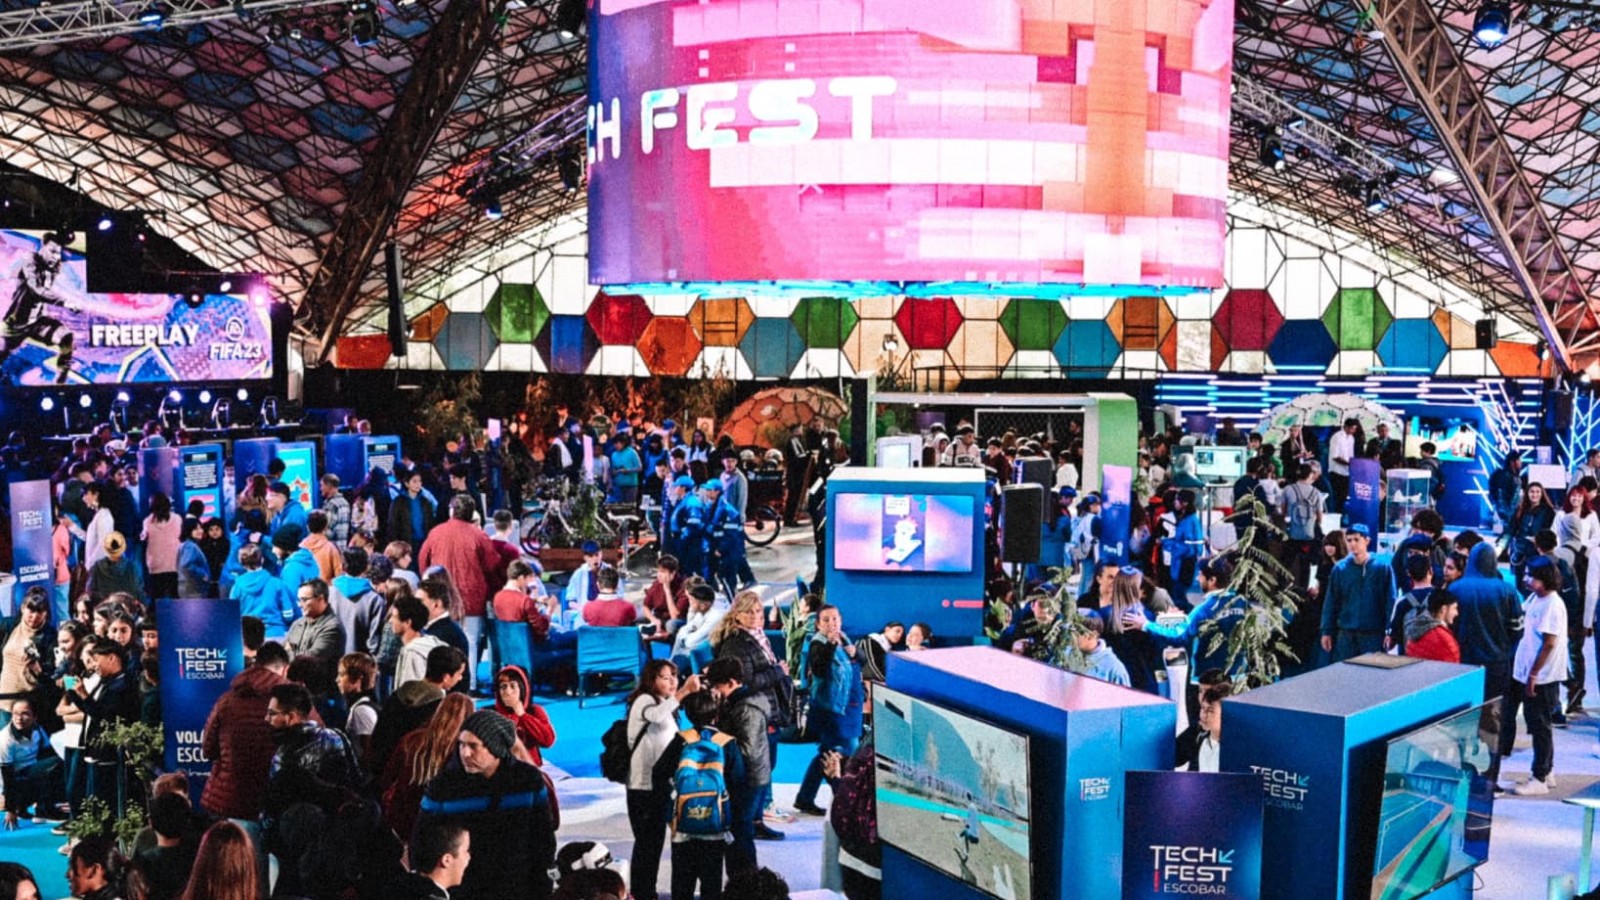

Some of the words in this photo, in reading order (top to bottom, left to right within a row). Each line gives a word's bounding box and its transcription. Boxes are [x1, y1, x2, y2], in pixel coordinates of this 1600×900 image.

[641, 76, 897, 154] FEST
[92, 324, 199, 347] FREEPLAY
[175, 648, 217, 664] TECH
[185, 660, 228, 671] FEST
[186, 671, 225, 680] ESCOBAR
[1079, 777, 1105, 791] TECH
[1084, 785, 1111, 795] FEST
[1149, 845, 1217, 869] TECH
[1164, 865, 1233, 883] FEST
[1163, 882, 1226, 895] ESCOBAR
